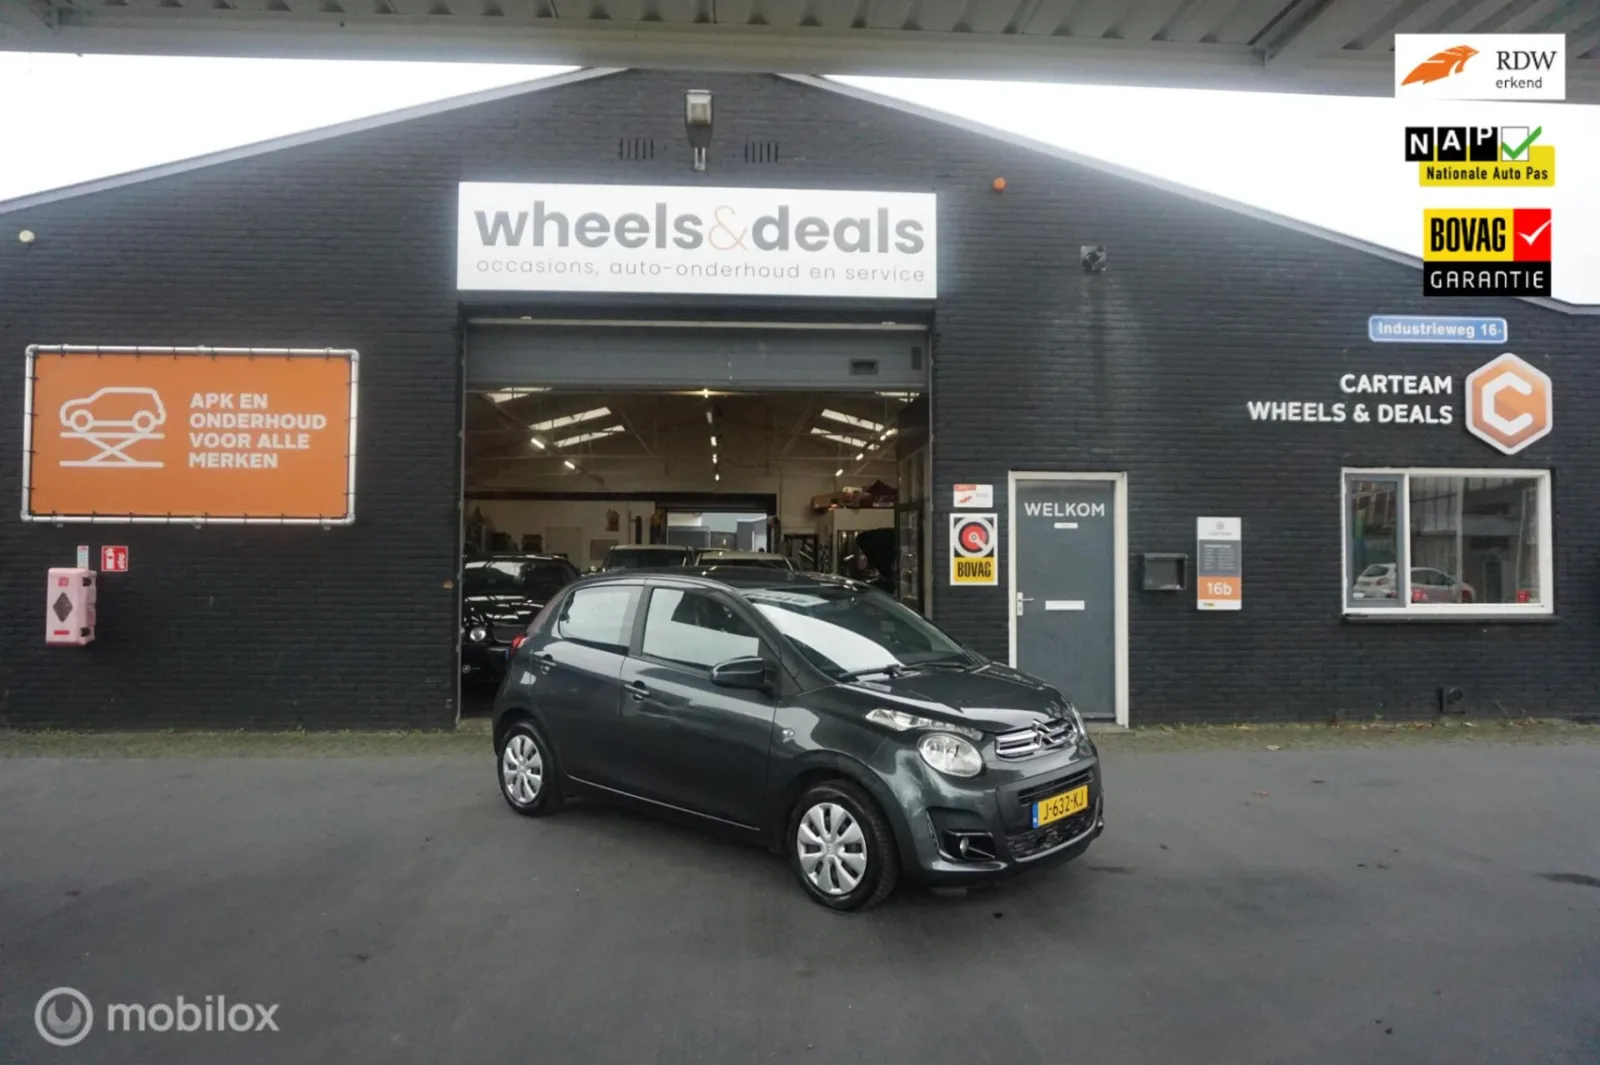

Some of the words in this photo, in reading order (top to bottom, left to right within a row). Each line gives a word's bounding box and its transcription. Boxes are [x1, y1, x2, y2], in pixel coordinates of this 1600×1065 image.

[474, 200, 925, 254] wheels&deals
[477, 257, 600, 277] occasions,
[609, 259, 800, 279] auto-onderhoud
[809, 266, 836, 280] en
[845, 266, 925, 282] service
[1378, 321, 1475, 339] Industrieweg
[1340, 374, 1452, 395] CARTEAM
[190, 393, 234, 410] APK
[240, 393, 268, 410] EN
[189, 413, 327, 429] ONDERHOUD
[1247, 401, 1347, 423] WHEELS
[1353, 404, 1370, 423] &
[1378, 404, 1453, 424] DEALS
[189, 433, 251, 449] VOOR
[257, 433, 310, 449] ALLE
[189, 452, 278, 469] MERKEN
[1024, 502, 1105, 517] WELKOM
[957, 561, 991, 578] BOVAG
[1206, 582, 1232, 596] 16b
[1043, 789, 1084, 820] J-632-KJ
